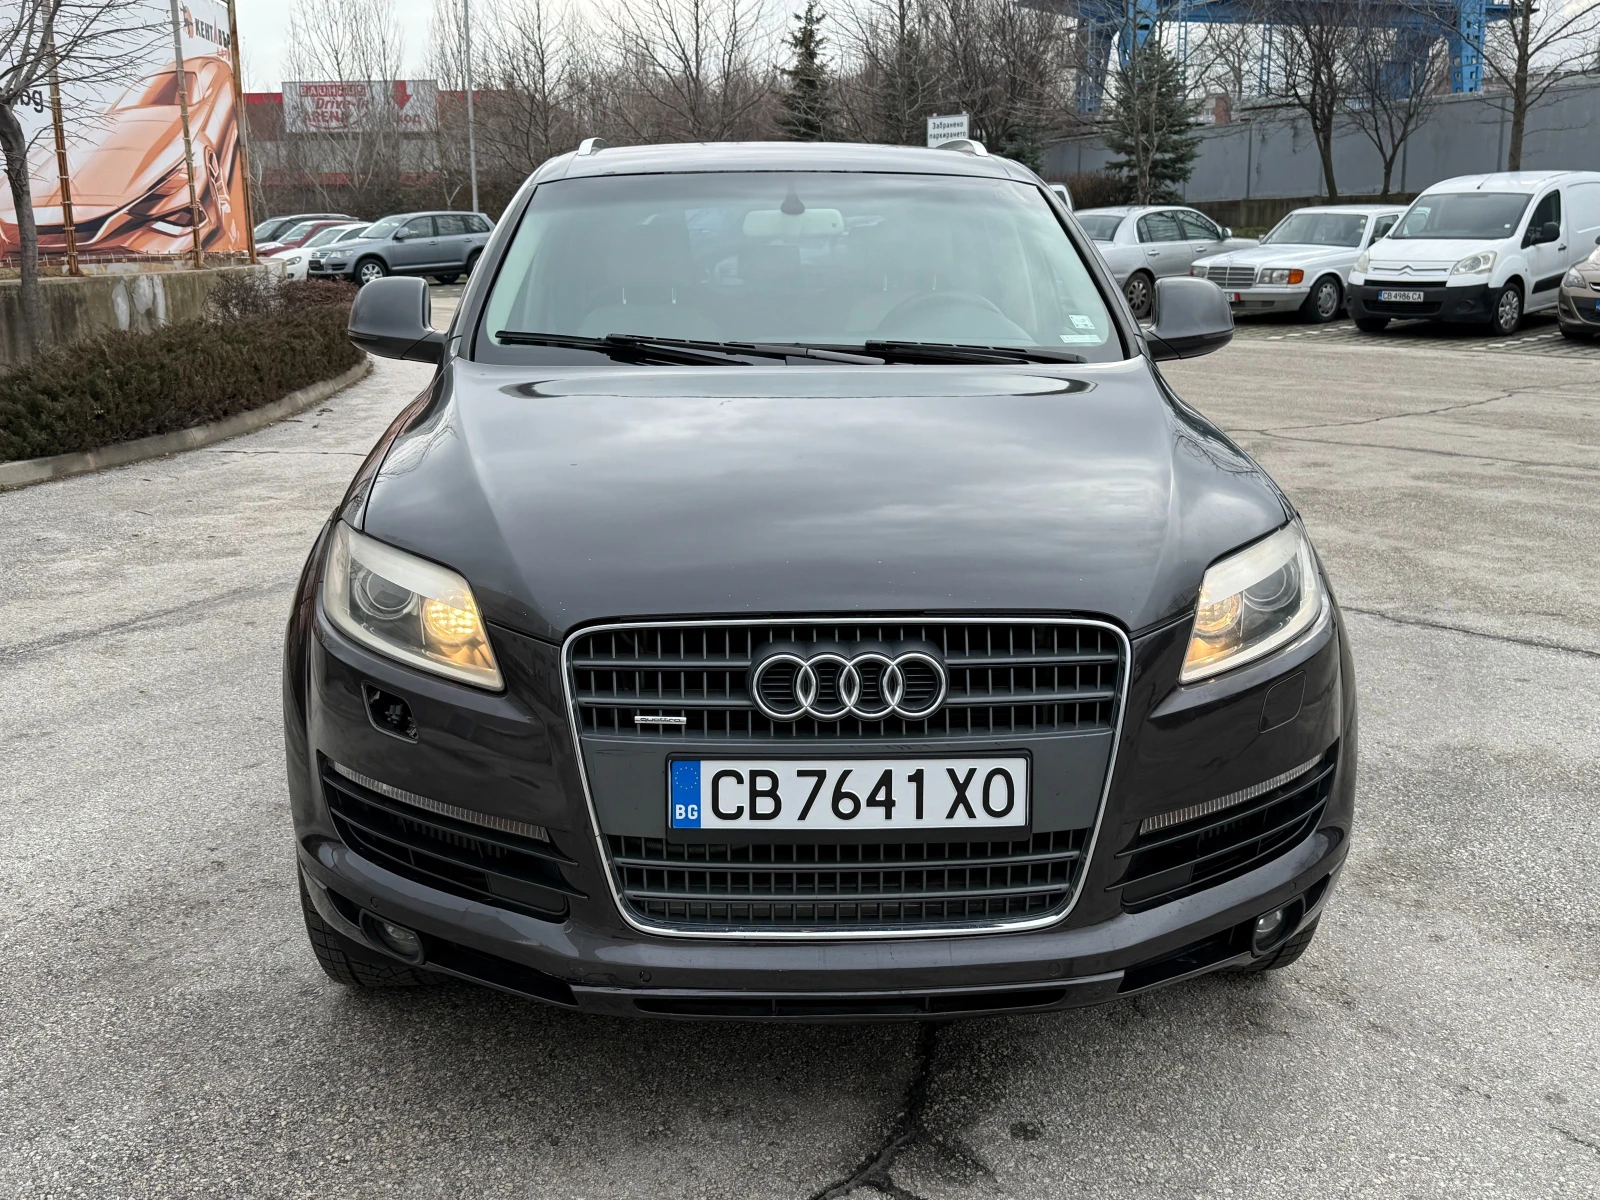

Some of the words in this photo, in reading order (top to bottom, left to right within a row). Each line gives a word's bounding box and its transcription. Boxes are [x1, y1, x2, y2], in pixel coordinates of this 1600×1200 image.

[300, 85, 366, 97] BAUHAUS
[932, 121, 964, 130] Забранено
[929, 131, 967, 140] паркирането
[1382, 292, 1392, 300] CB
[1393, 292, 1411, 301] 4986
[1411, 292, 1422, 301] CA
[711, 769, 782, 820] CB
[796, 769, 926, 820] 7641
[945, 767, 1015, 818] XO
[675, 804, 698, 820] BG
